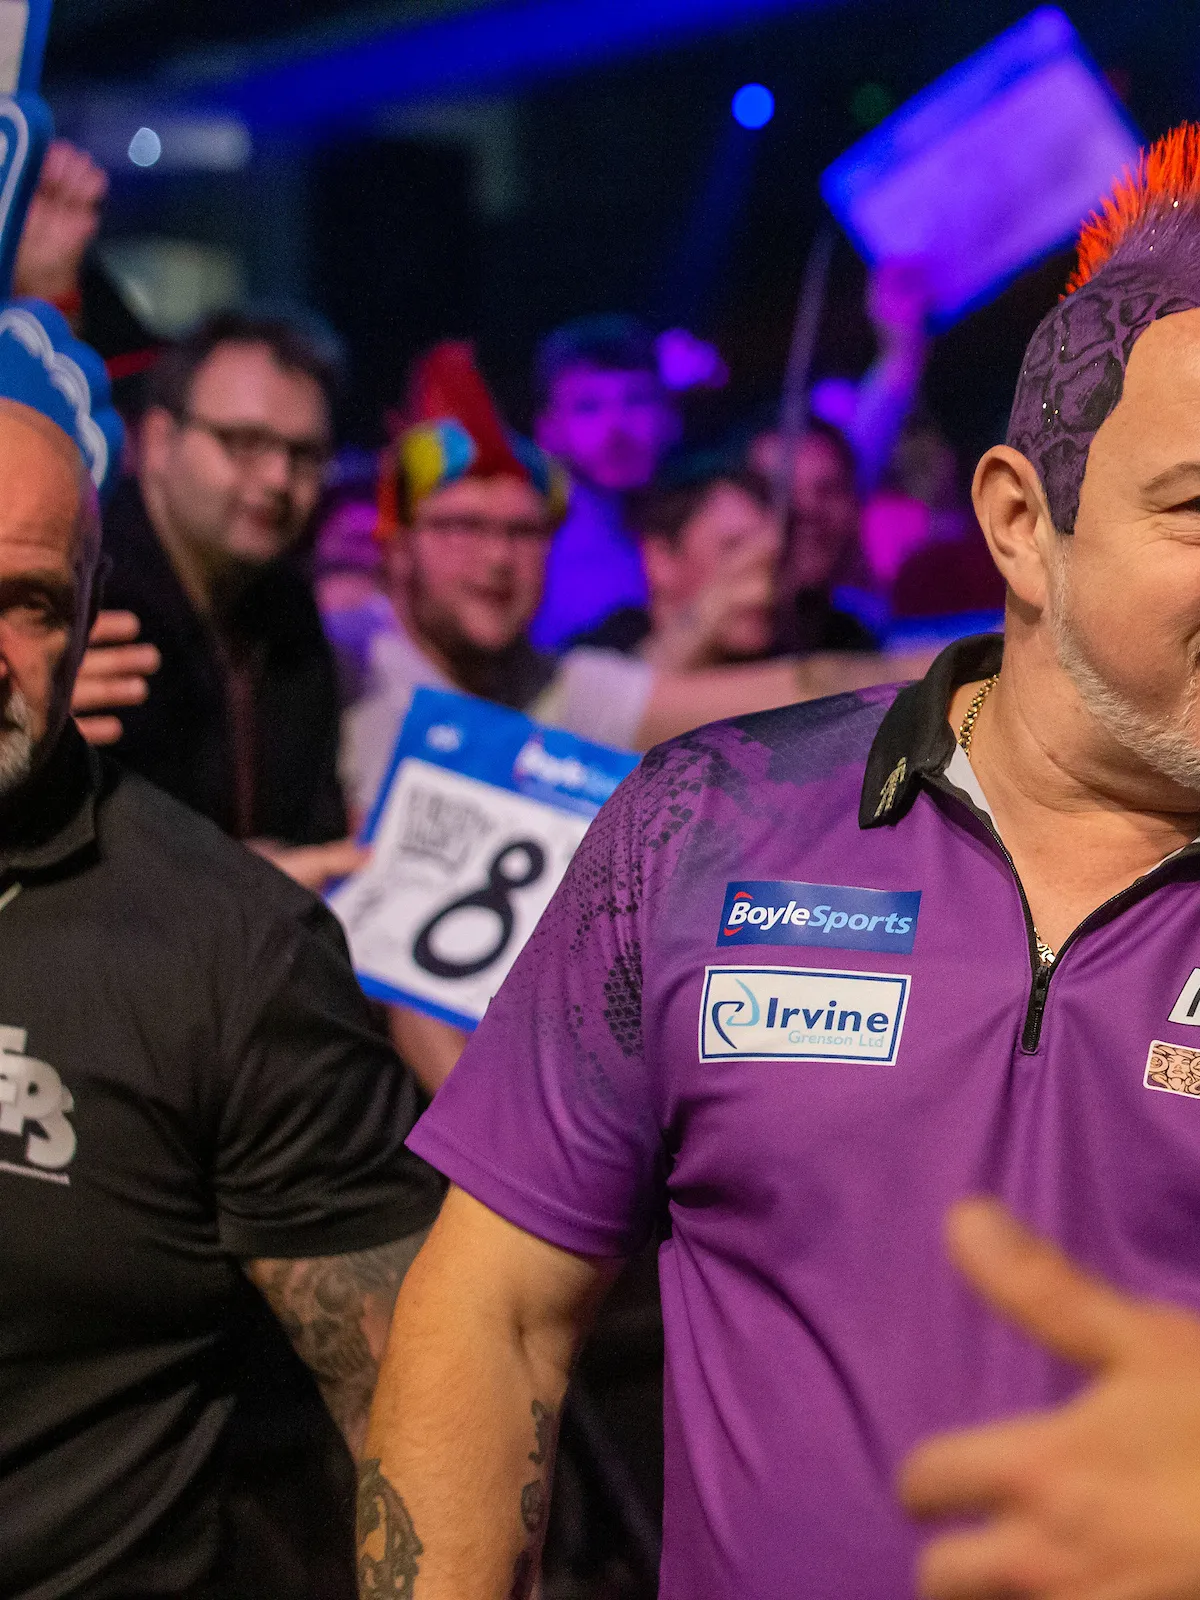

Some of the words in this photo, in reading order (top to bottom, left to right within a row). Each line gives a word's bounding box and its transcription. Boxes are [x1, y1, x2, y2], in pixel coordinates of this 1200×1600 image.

[411, 839, 546, 980] 8
[727, 900, 913, 934] BoyleSports
[766, 997, 889, 1033] Irvine
[788, 1030, 853, 1046] Grenson
[859, 1034, 884, 1048] Ltd
